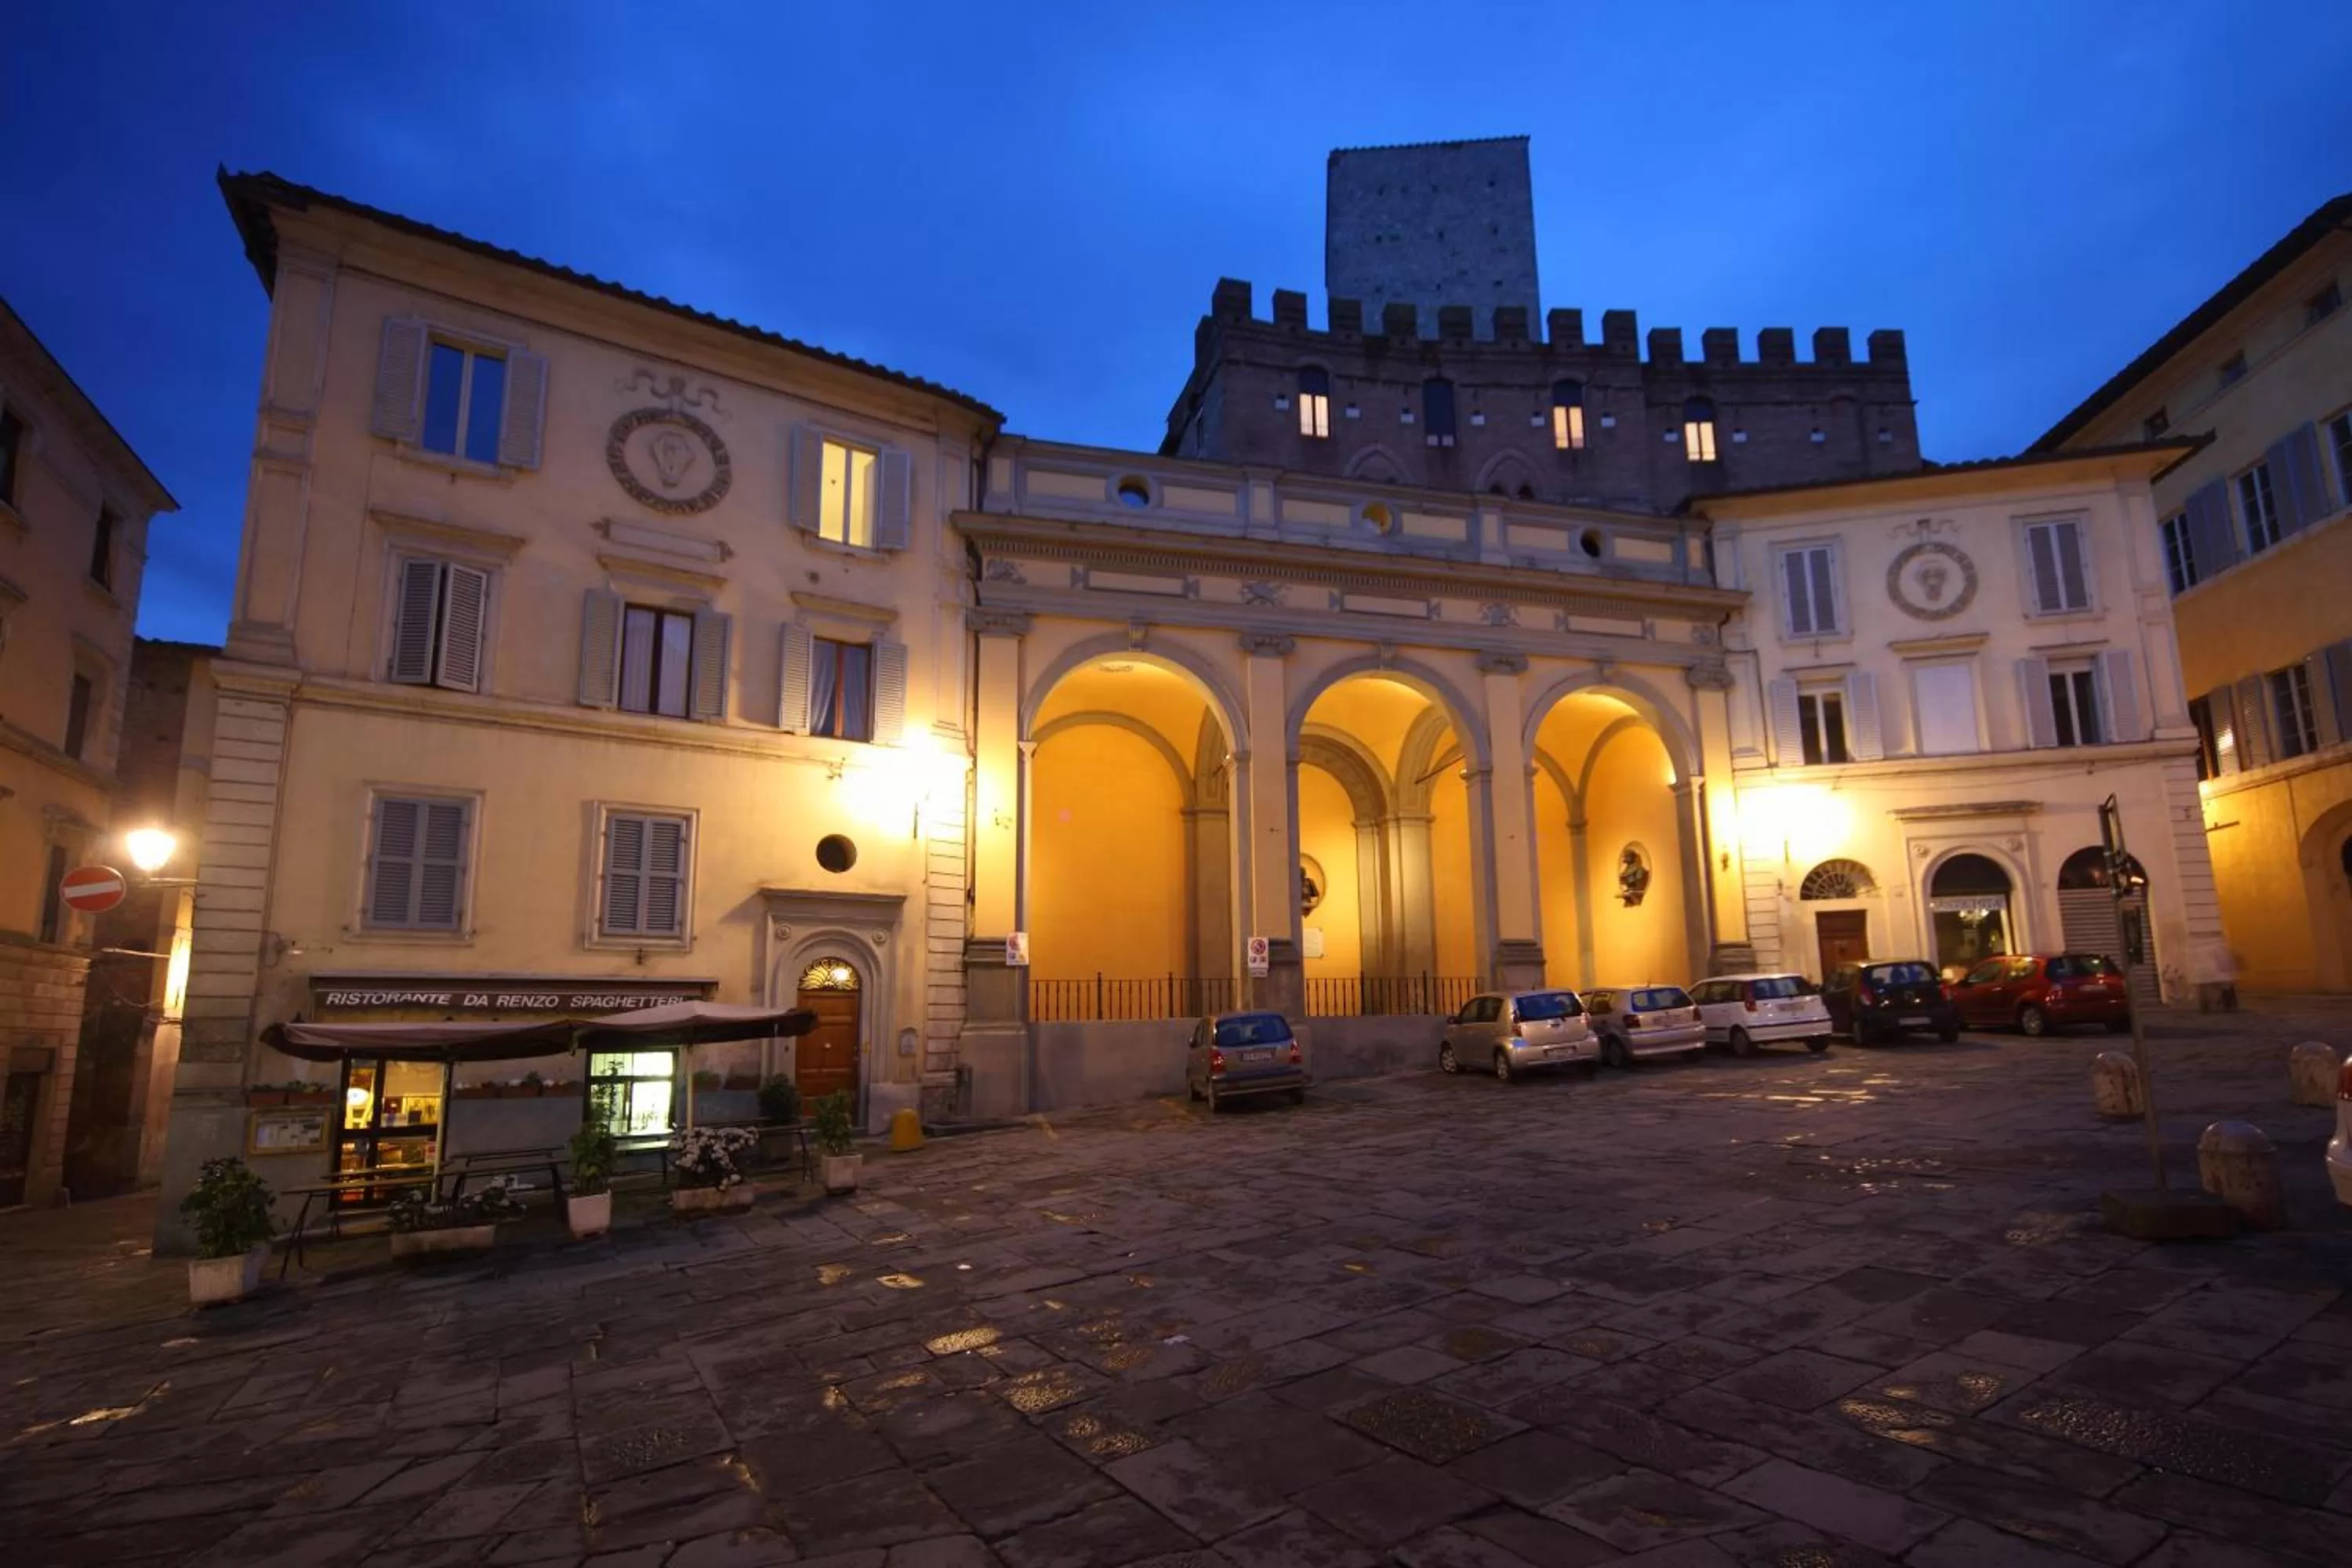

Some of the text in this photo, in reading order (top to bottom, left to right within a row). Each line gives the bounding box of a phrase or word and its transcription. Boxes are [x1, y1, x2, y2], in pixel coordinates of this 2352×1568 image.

[326, 992, 452, 1005] RISTORANTE
[463, 993, 488, 1007] DA
[495, 994, 559, 1007] RENZO
